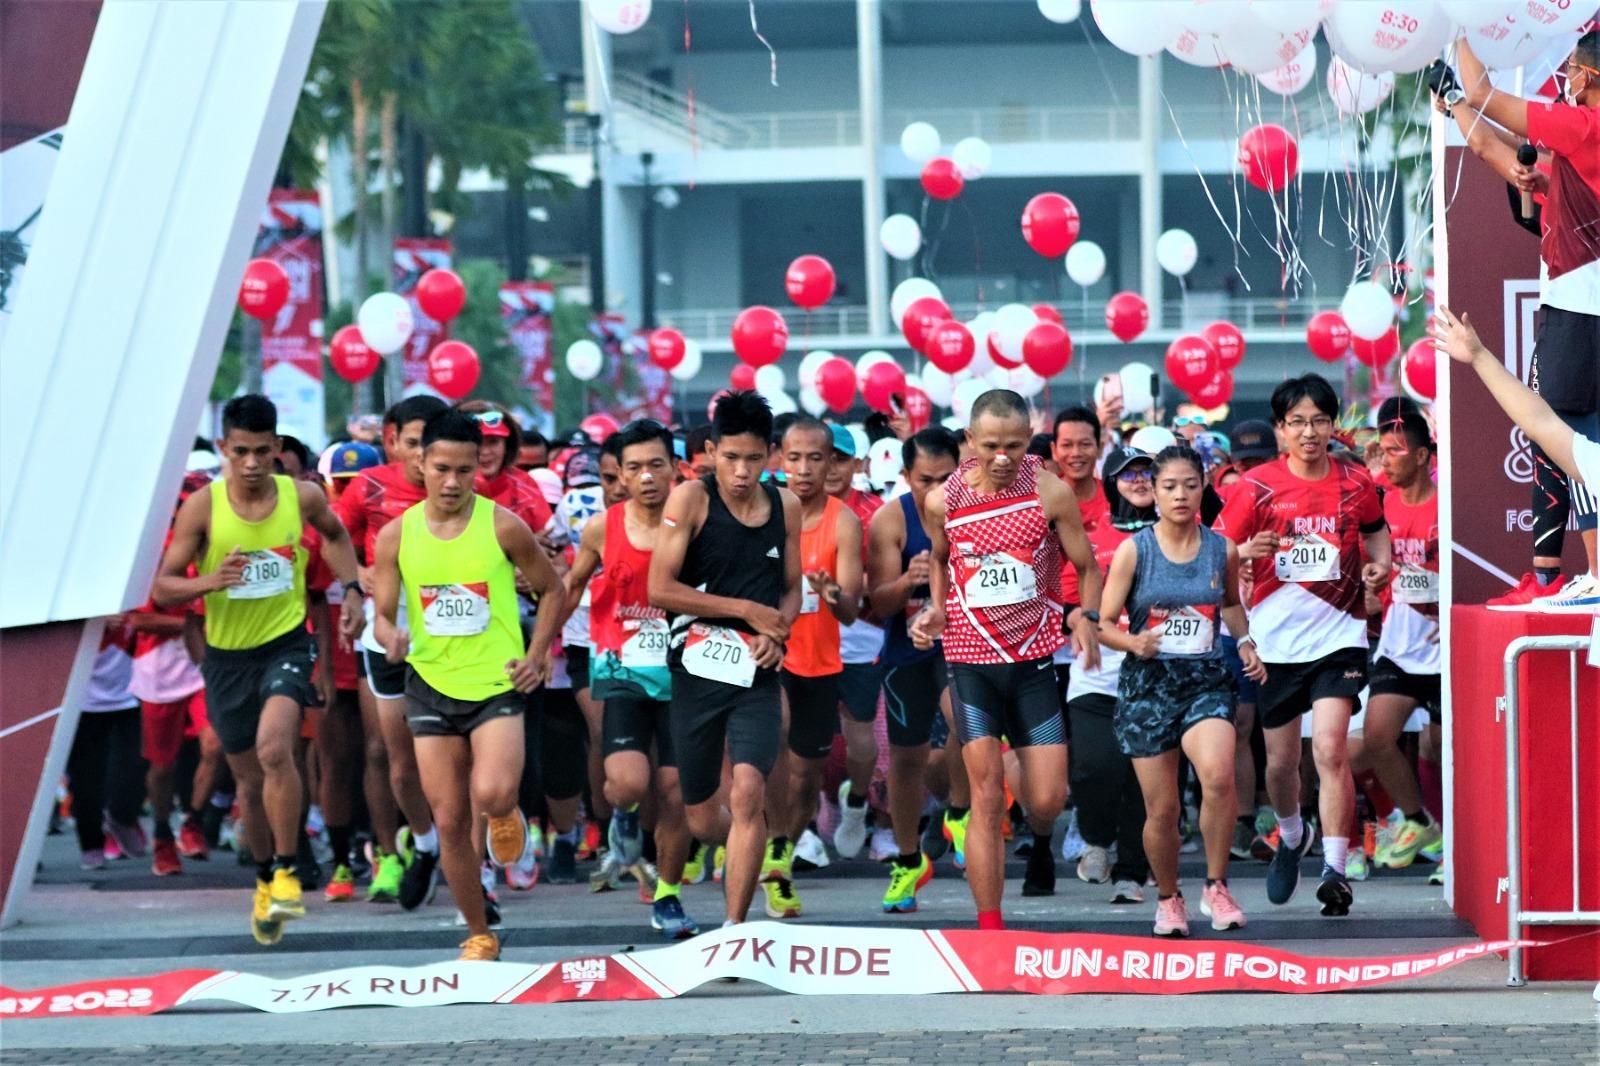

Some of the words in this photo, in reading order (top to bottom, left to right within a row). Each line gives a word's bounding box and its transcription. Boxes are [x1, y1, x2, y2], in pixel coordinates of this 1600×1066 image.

[1380, 10, 1418, 34] 8:30
[1294, 516, 1336, 535] RUN
[1292, 547, 1327, 565] 2014
[1394, 538, 1426, 556] RUN
[244, 561, 280, 582] 2180
[979, 566, 1019, 588] 2341
[1399, 574, 1430, 589] 2288
[435, 598, 474, 617] 2502
[1164, 619, 1201, 636] 2597
[702, 639, 742, 665] 2270
[562, 958, 606, 974] RUN
[701, 937, 776, 968] 77K
[789, 945, 891, 976] RIDE
[1223, 952, 1308, 985] FOR
[271, 979, 352, 1003] 7.7K
[369, 973, 459, 996] RUN
[574, 981, 596, 998] 7
[48, 987, 153, 1013] 2022
